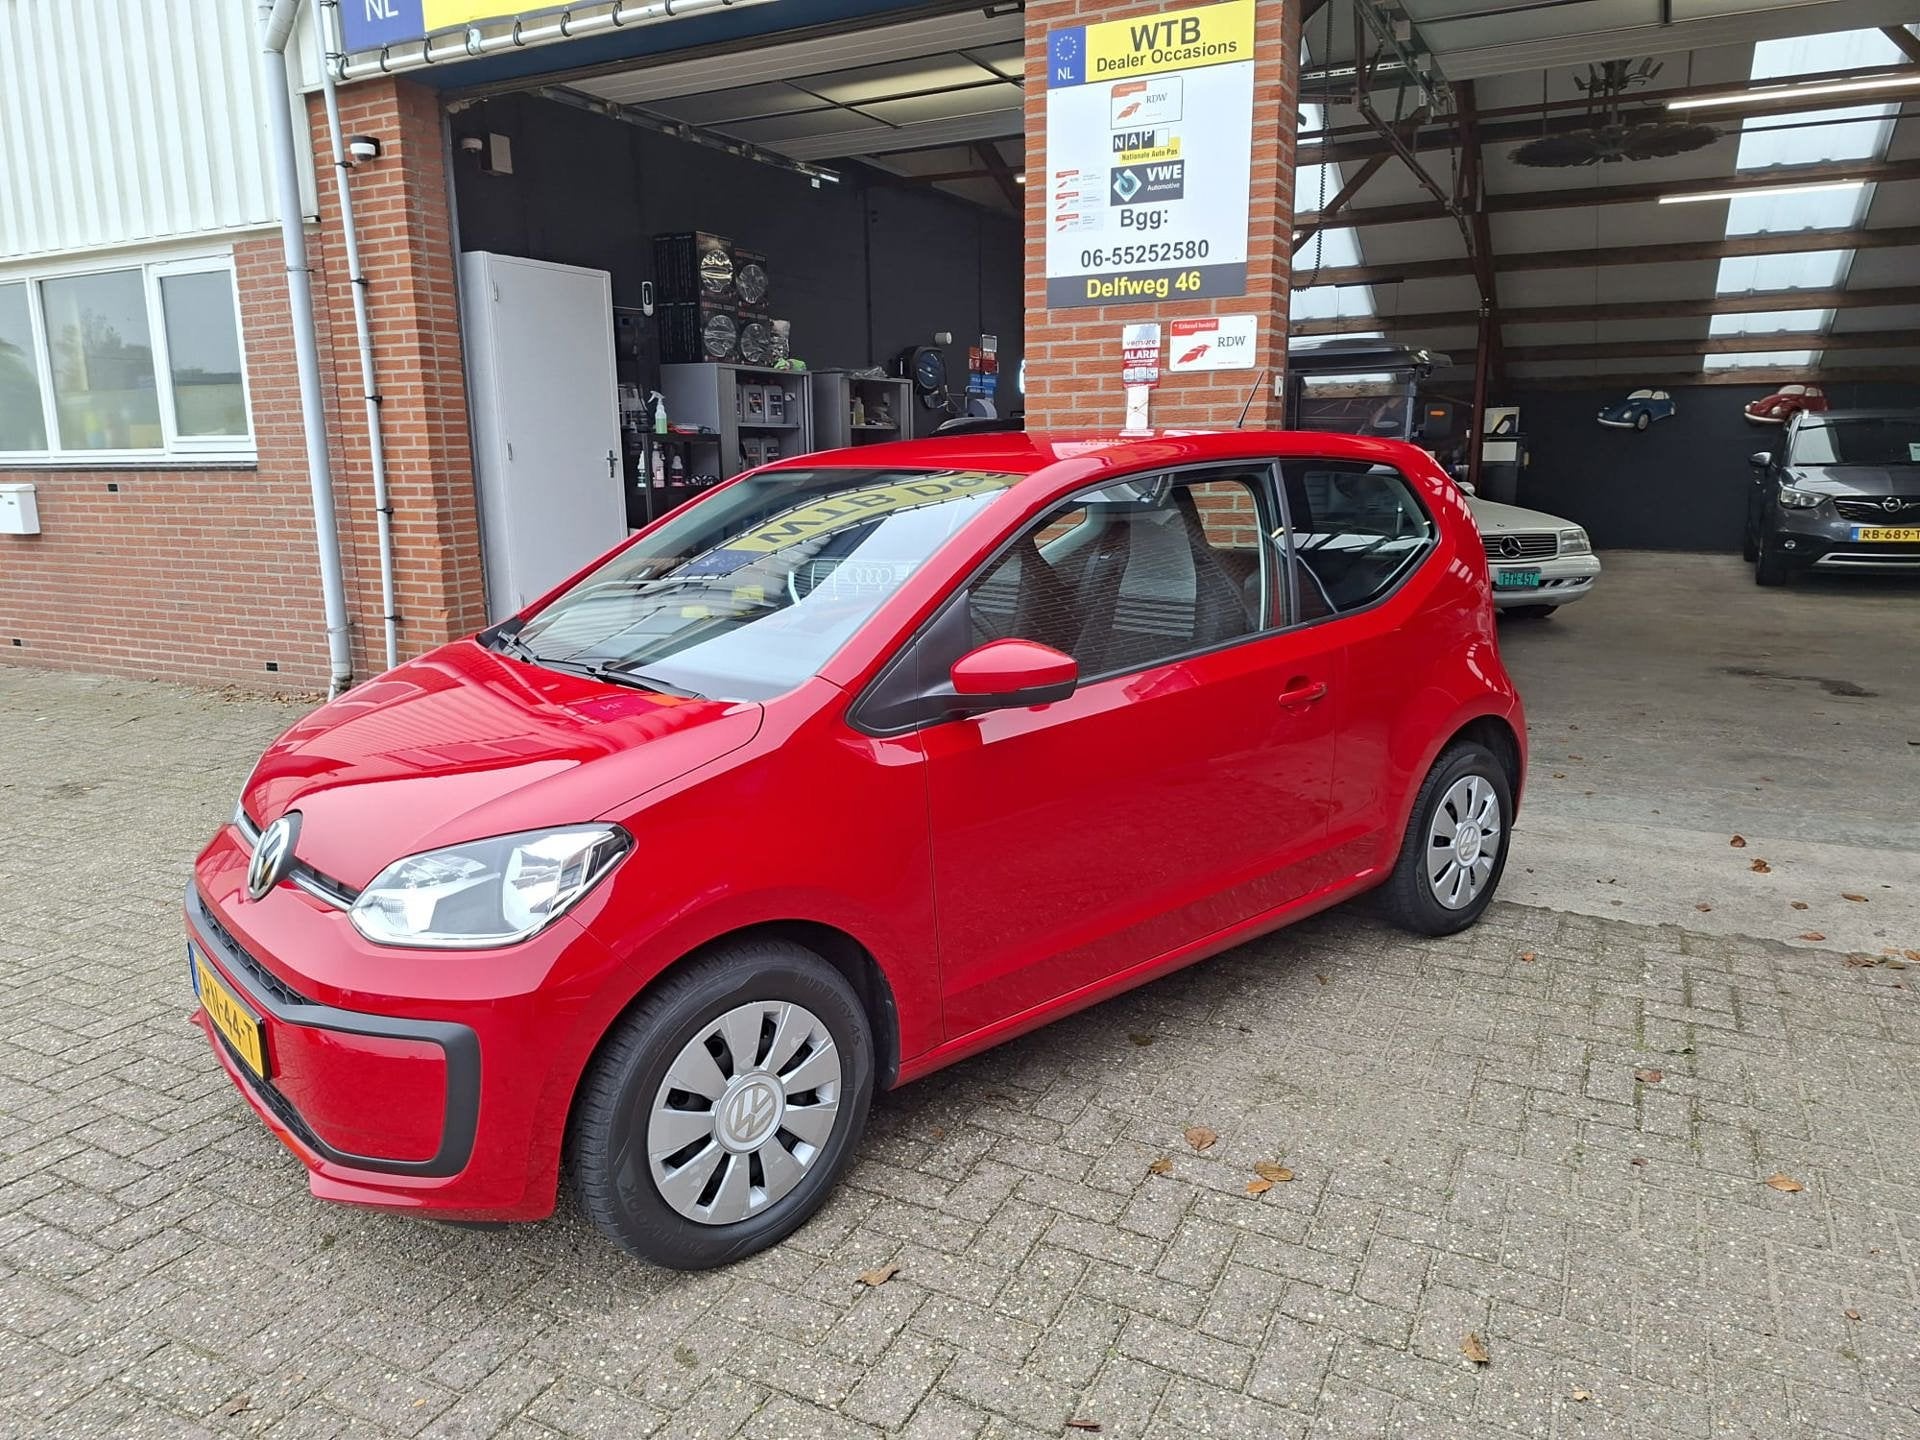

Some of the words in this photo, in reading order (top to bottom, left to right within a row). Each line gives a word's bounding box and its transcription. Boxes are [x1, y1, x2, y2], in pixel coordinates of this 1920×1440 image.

[365, 0, 399, 21] NL
[1131, 17, 1201, 52] WTB
[1096, 53, 1147, 72] Dealer
[1151, 39, 1237, 63] Occasions
[1057, 68, 1074, 80] NL
[1146, 93, 1168, 104] RDW
[1114, 130, 1153, 149] NAP
[1121, 150, 1150, 162] Nationale
[1151, 149, 1165, 158] Auto
[1167, 148, 1178, 156] Pas
[1147, 165, 1182, 182] VWE
[1147, 182, 1181, 192] Automotive
[1120, 208, 1169, 231] Bgg:
[1081, 240, 1209, 268] 06-55252580
[1086, 277, 1169, 299] Delfweg
[1175, 271, 1201, 291] 46
[1217, 335, 1246, 347] RDW
[1124, 349, 1159, 360] ALARM
